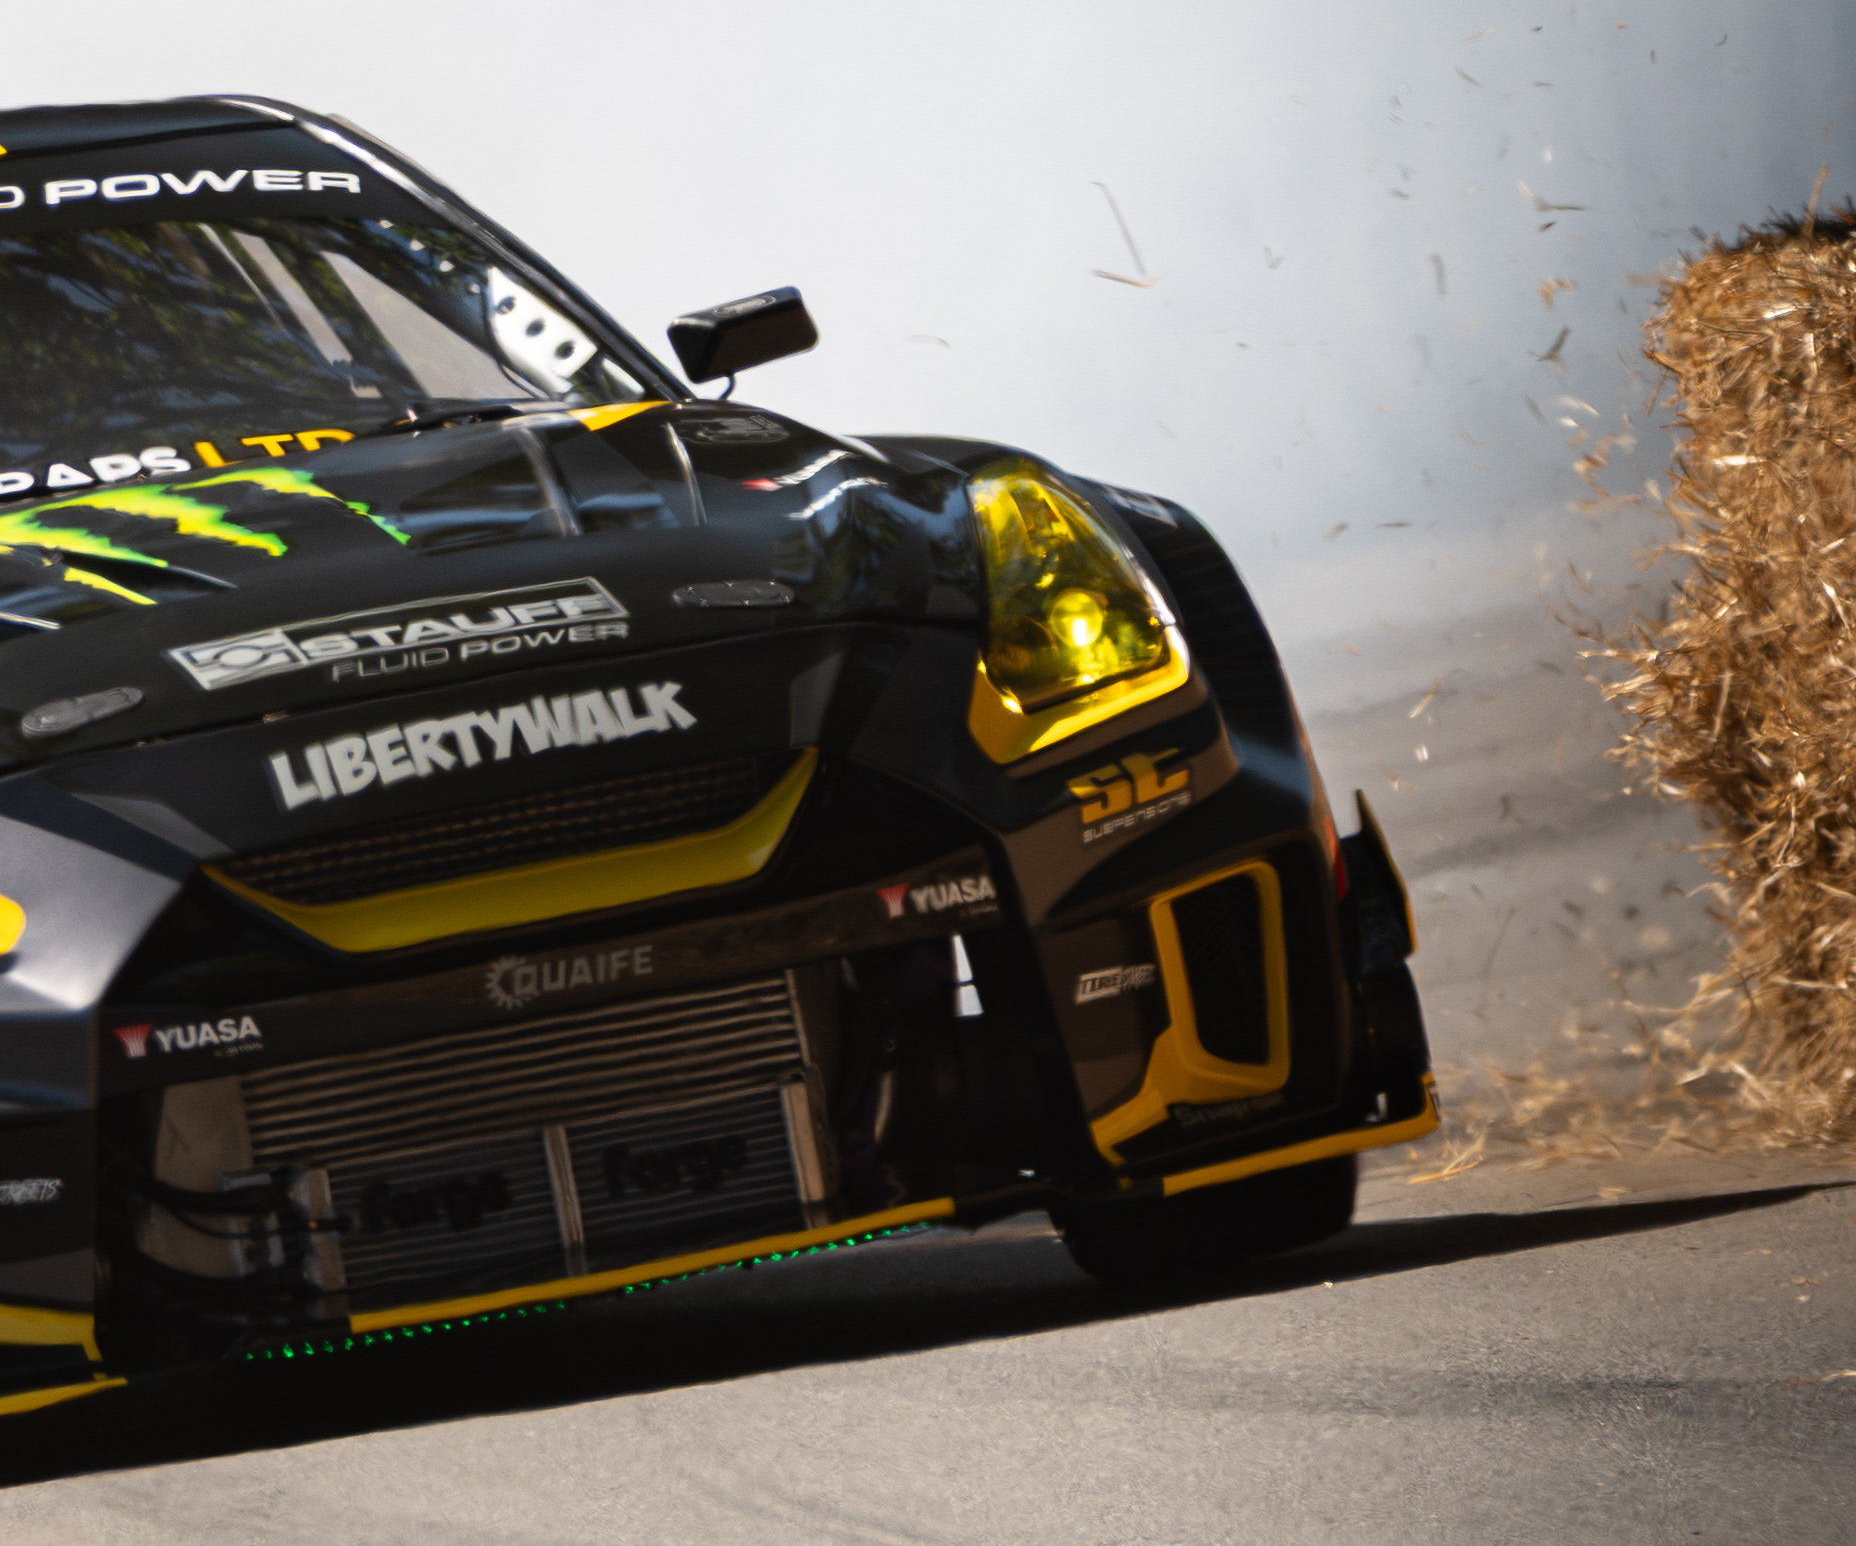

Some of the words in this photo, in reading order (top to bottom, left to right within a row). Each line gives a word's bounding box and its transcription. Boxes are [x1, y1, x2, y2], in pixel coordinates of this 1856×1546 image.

[45, 168, 361, 207] POWER
[296, 594, 611, 657] STAUFF
[332, 645, 451, 683] FLUID
[460, 621, 630, 660] POWER
[908, 873, 998, 915] YUASA
[510, 944, 654, 1001] QUAIFE
[154, 1015, 262, 1054] YUASA
